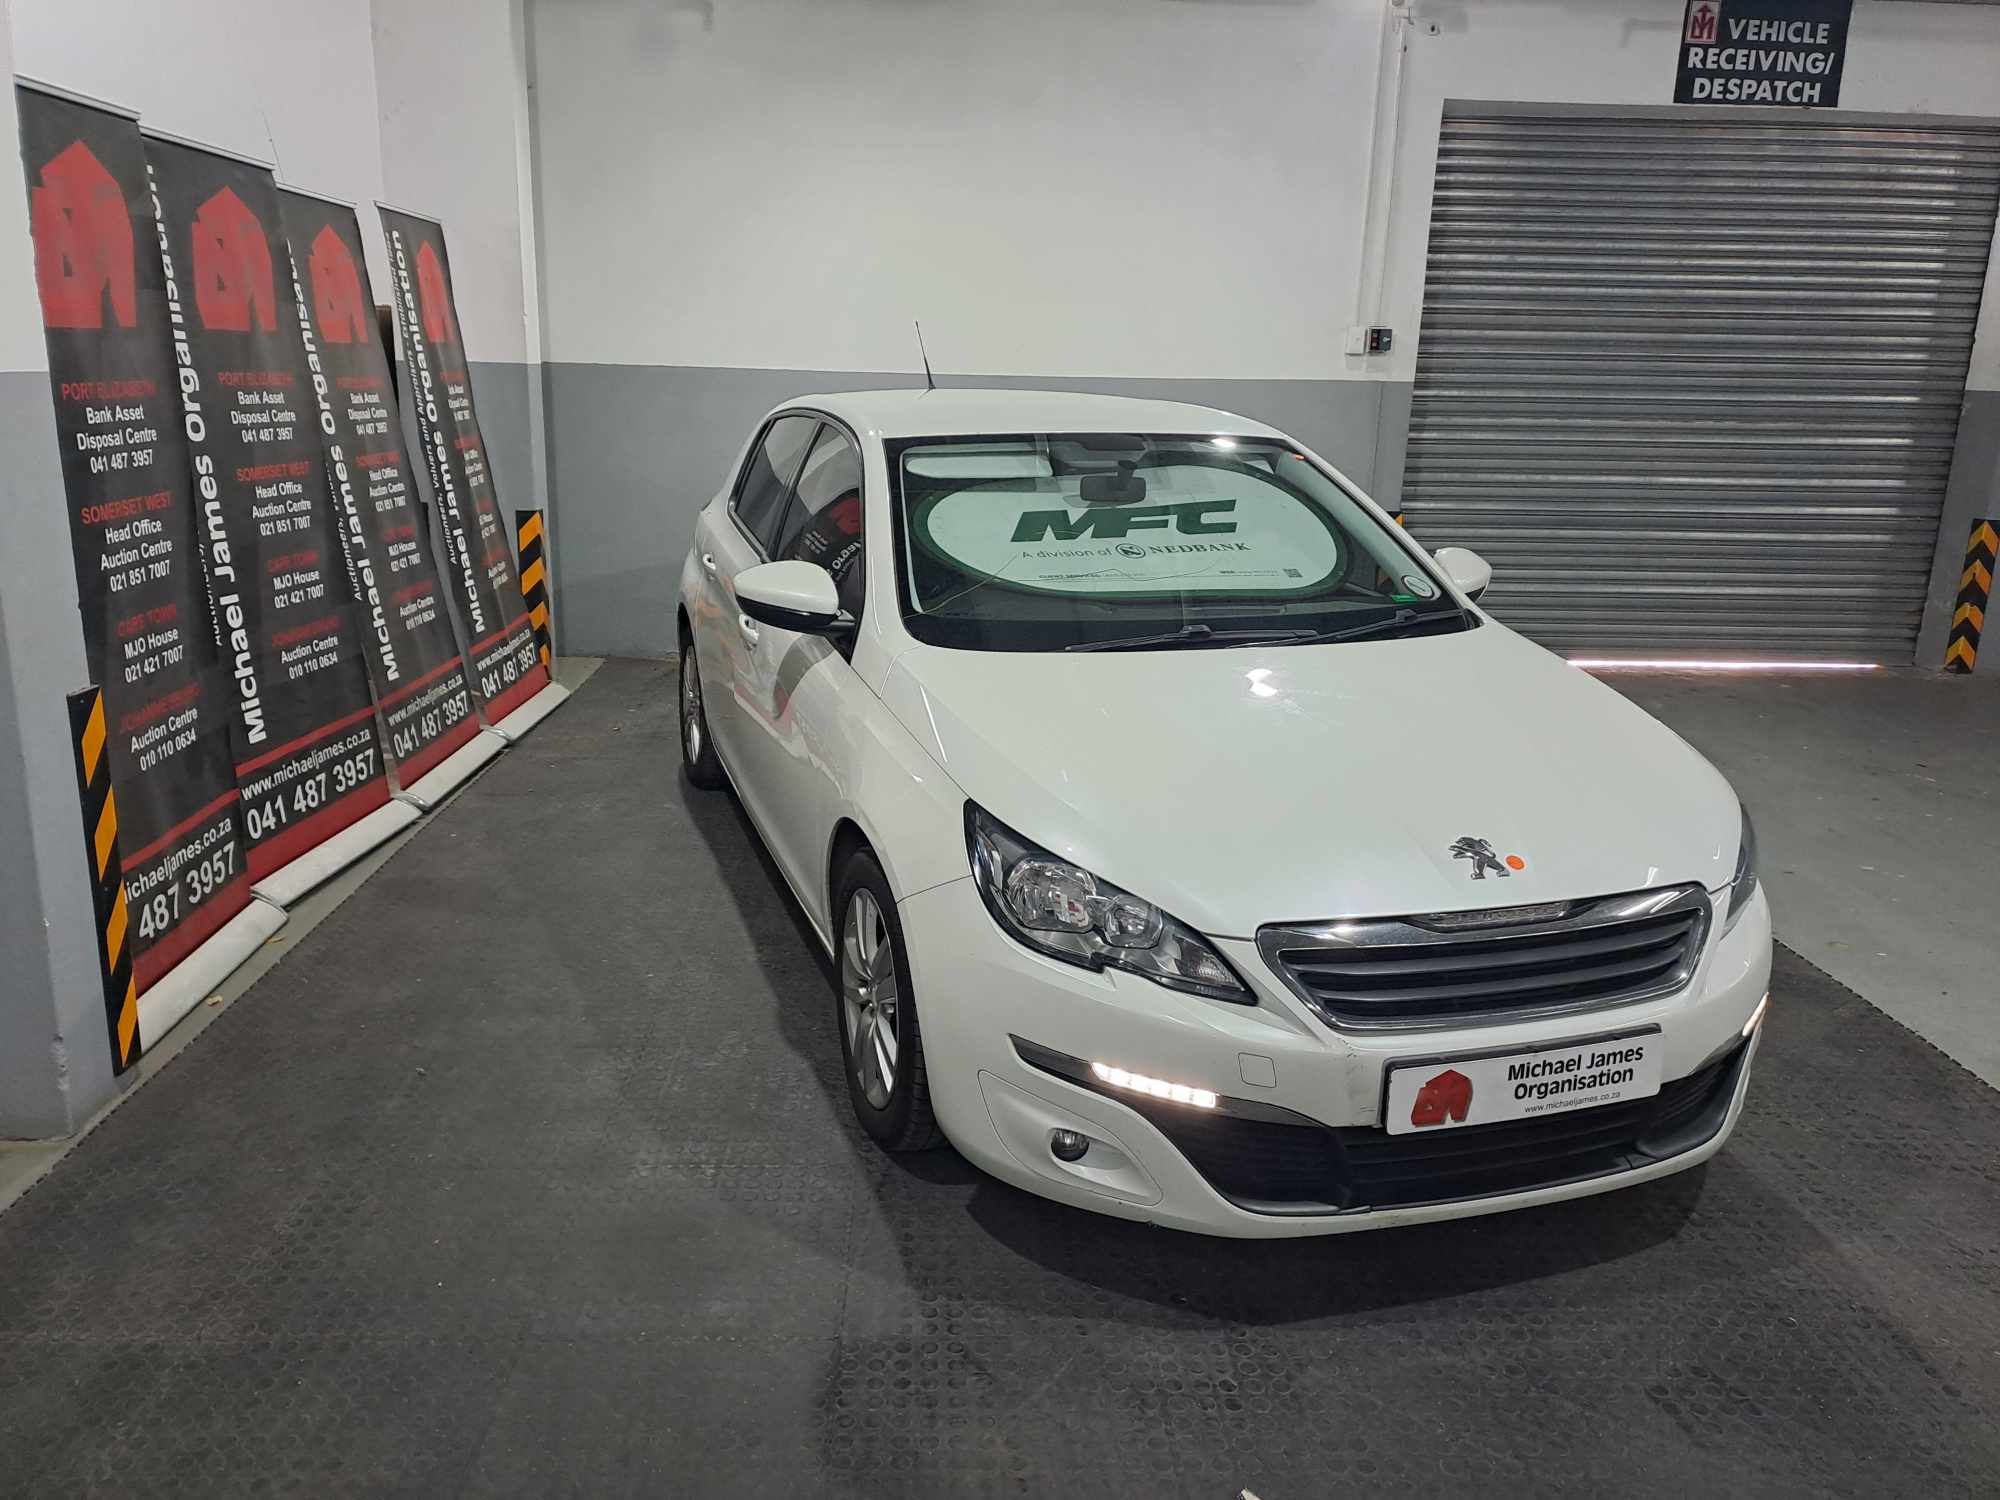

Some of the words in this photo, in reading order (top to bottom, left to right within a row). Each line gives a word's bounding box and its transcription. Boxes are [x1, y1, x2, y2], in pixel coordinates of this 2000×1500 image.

[1728, 18, 1830, 44] VEHICLE
[1688, 47, 1835, 74] RECEIVING/
[1693, 78, 1821, 103] DESPATCH
[392, 230, 438, 422] Organisation
[62, 383, 90, 400] PORT
[238, 391, 261, 405] Bank
[263, 391, 284, 404] Asset
[86, 406, 113, 424] Bank
[115, 404, 144, 422] Asset
[230, 410, 270, 426] Disposal
[272, 410, 296, 422] Centre
[420, 417, 430, 442] and
[76, 430, 123, 451] Disposal
[126, 427, 157, 444] Centre
[242, 430, 256, 443] 041
[260, 428, 274, 442] 487
[277, 427, 293, 440] 3957
[90, 456, 108, 474] 041
[111, 452, 128, 470] 487
[132, 449, 152, 468] 3957
[426, 445, 440, 488] Valuers
[434, 431, 460, 520] James
[255, 486, 277, 498] Head
[279, 482, 302, 496] Office
[331, 445, 365, 548] James
[80, 496, 143, 524] SOMERSET
[145, 492, 172, 510] WEST
[196, 454, 235, 582] James
[252, 503, 285, 518] Auction
[286, 499, 311, 514] Centre
[1010, 499, 1237, 542] MFC
[104, 526, 130, 544] Head
[132, 518, 162, 538] Office
[260, 522, 275, 536] 021
[277, 519, 291, 532] 851
[294, 516, 310, 529] 7007
[100, 546, 139, 571] Auction
[140, 539, 172, 558] Centre
[1022, 551, 1033, 559] A
[1037, 550, 1094, 558] division
[1098, 548, 1112, 556] of
[1149, 543, 1251, 554] NEDBANK
[110, 574, 128, 592] 021
[129, 567, 146, 586] 851
[148, 560, 170, 580] 7007
[273, 575, 292, 590] MJO
[293, 570, 319, 584] House
[453, 528, 485, 633] Michael
[274, 596, 288, 608] 021
[291, 591, 304, 604] 421
[307, 584, 324, 599] 7007
[357, 558, 399, 681] Michael
[124, 637, 146, 659] MJO
[148, 628, 179, 649] House
[281, 645, 311, 664] Auction
[313, 635, 338, 651] Centre
[124, 664, 141, 683] 021
[144, 655, 160, 674] 421
[162, 645, 184, 668] 7007
[220, 594, 267, 744] Michael
[289, 666, 302, 680] 010
[304, 659, 318, 673] 110
[319, 652, 338, 668] 0634
[482, 669, 502, 698] 041
[503, 656, 519, 684] 487
[518, 642, 536, 672] 3957
[131, 724, 166, 752] Auction
[168, 708, 198, 732] Centre
[394, 724, 419, 758] 041
[422, 708, 442, 740] 487
[442, 690, 468, 725] 3957
[140, 752, 156, 772] 010
[158, 741, 173, 760] 110
[175, 728, 197, 751] 0634
[241, 728, 371, 800] www.michaeljames.co.za
[247, 795, 286, 840] 041
[294, 772, 326, 812] 487
[333, 748, 374, 792] 3957
[139, 882, 179, 938] 487
[186, 841, 235, 904] 3957
[1508, 1054, 1581, 1081] Michael
[1586, 1047, 1643, 1070] James
[1515, 1068, 1633, 1100] Organisation
[1525, 1091, 1620, 1113] www.michaeljames.co.za
